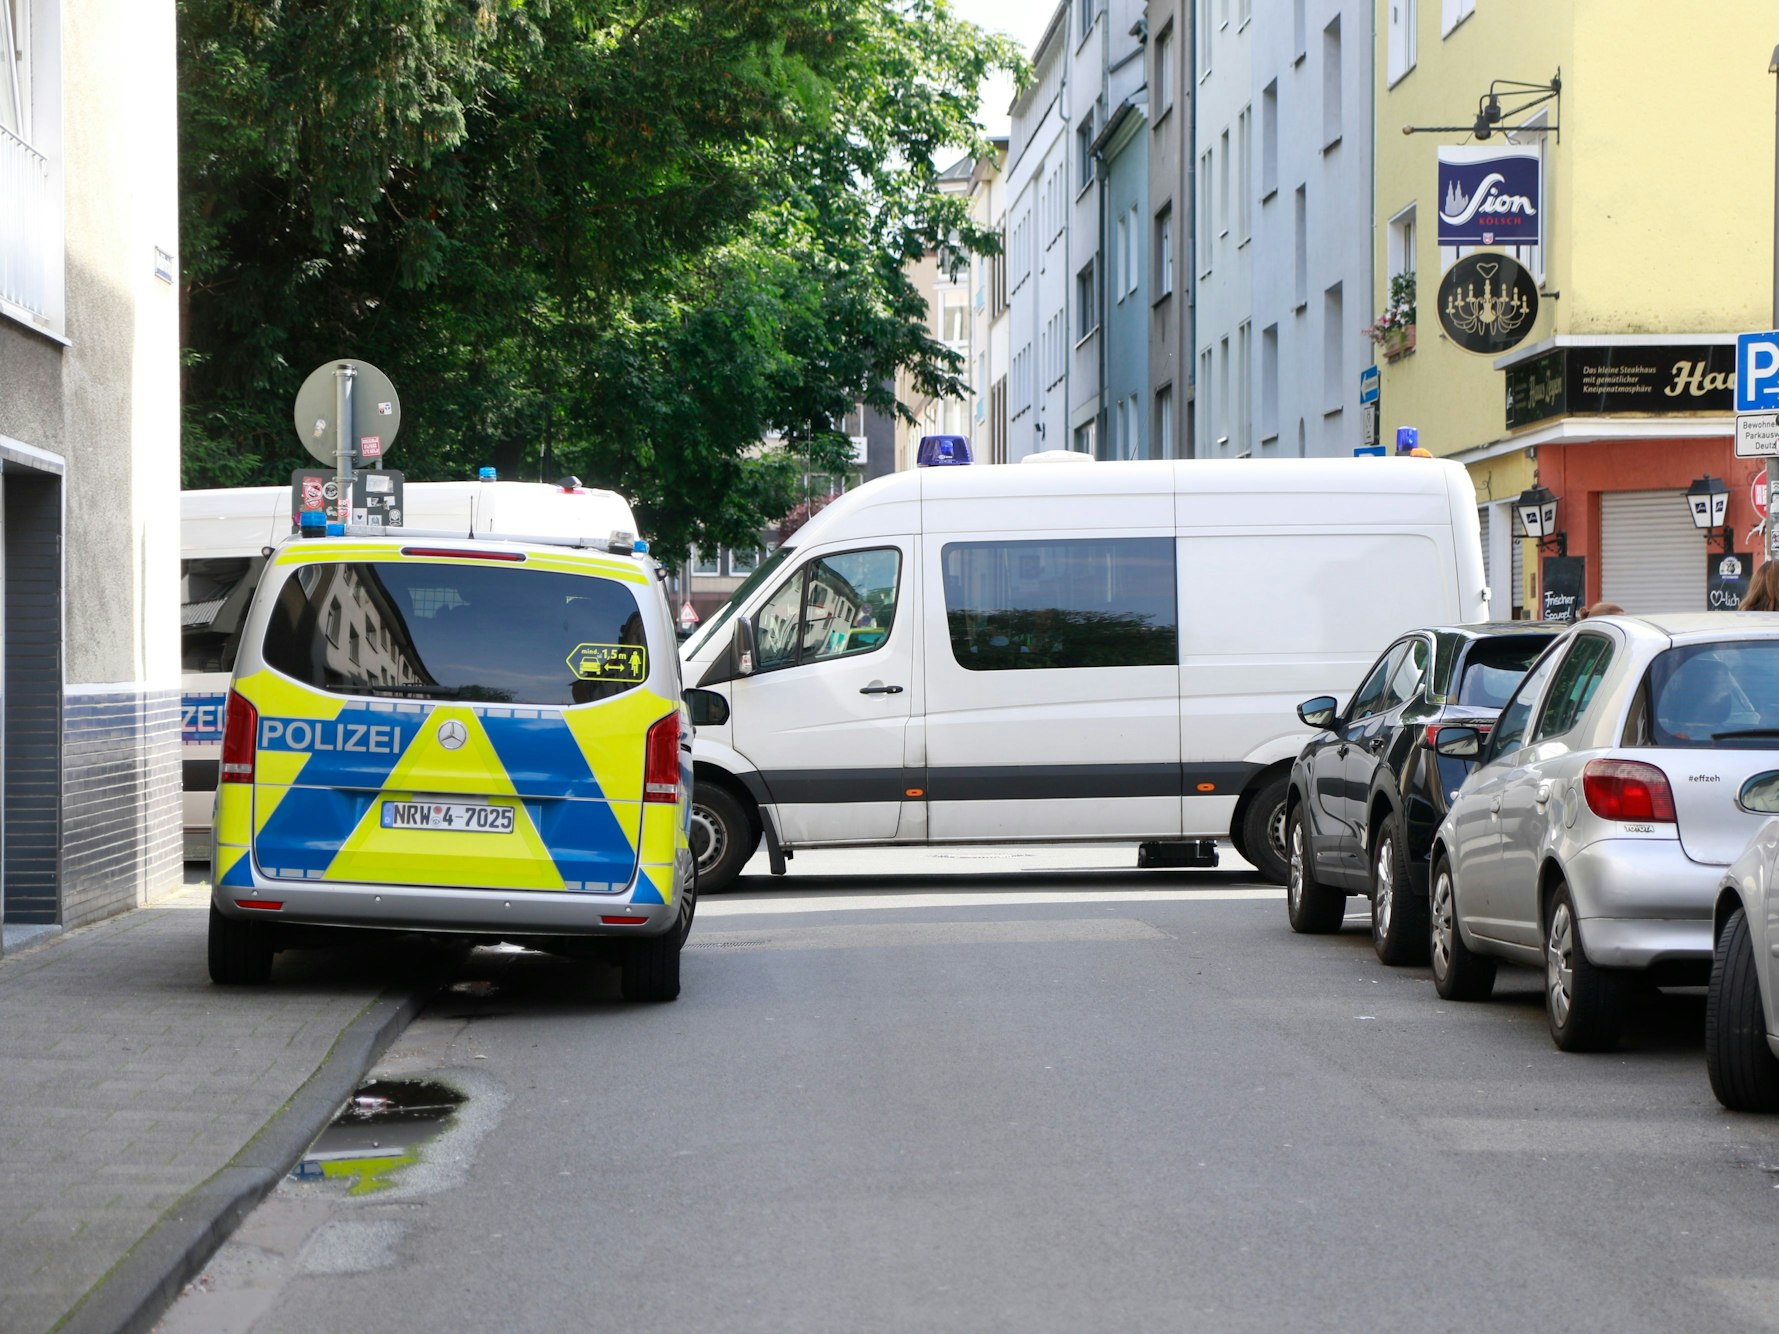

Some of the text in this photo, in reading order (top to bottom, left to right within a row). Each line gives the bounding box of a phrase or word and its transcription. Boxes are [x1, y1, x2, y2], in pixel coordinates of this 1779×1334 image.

[1440, 173, 1537, 226] Sion
[1583, 366, 1657, 374] Das kleine Steakhaus
[1747, 342, 1779, 402] P
[1596, 375, 1639, 385] gemütlicher
[1583, 384, 1652, 394] Kneipenatmosphäre
[1743, 421, 1778, 429] Bewohne
[1544, 591, 1575, 608] Frischer
[261, 719, 400, 754] POLIZEI
[1688, 774, 1720, 783] #effzeh
[393, 804, 431, 826] NRW
[442, 806, 512, 829] 4-7025
[1625, 824, 1655, 833] TOYOTA
